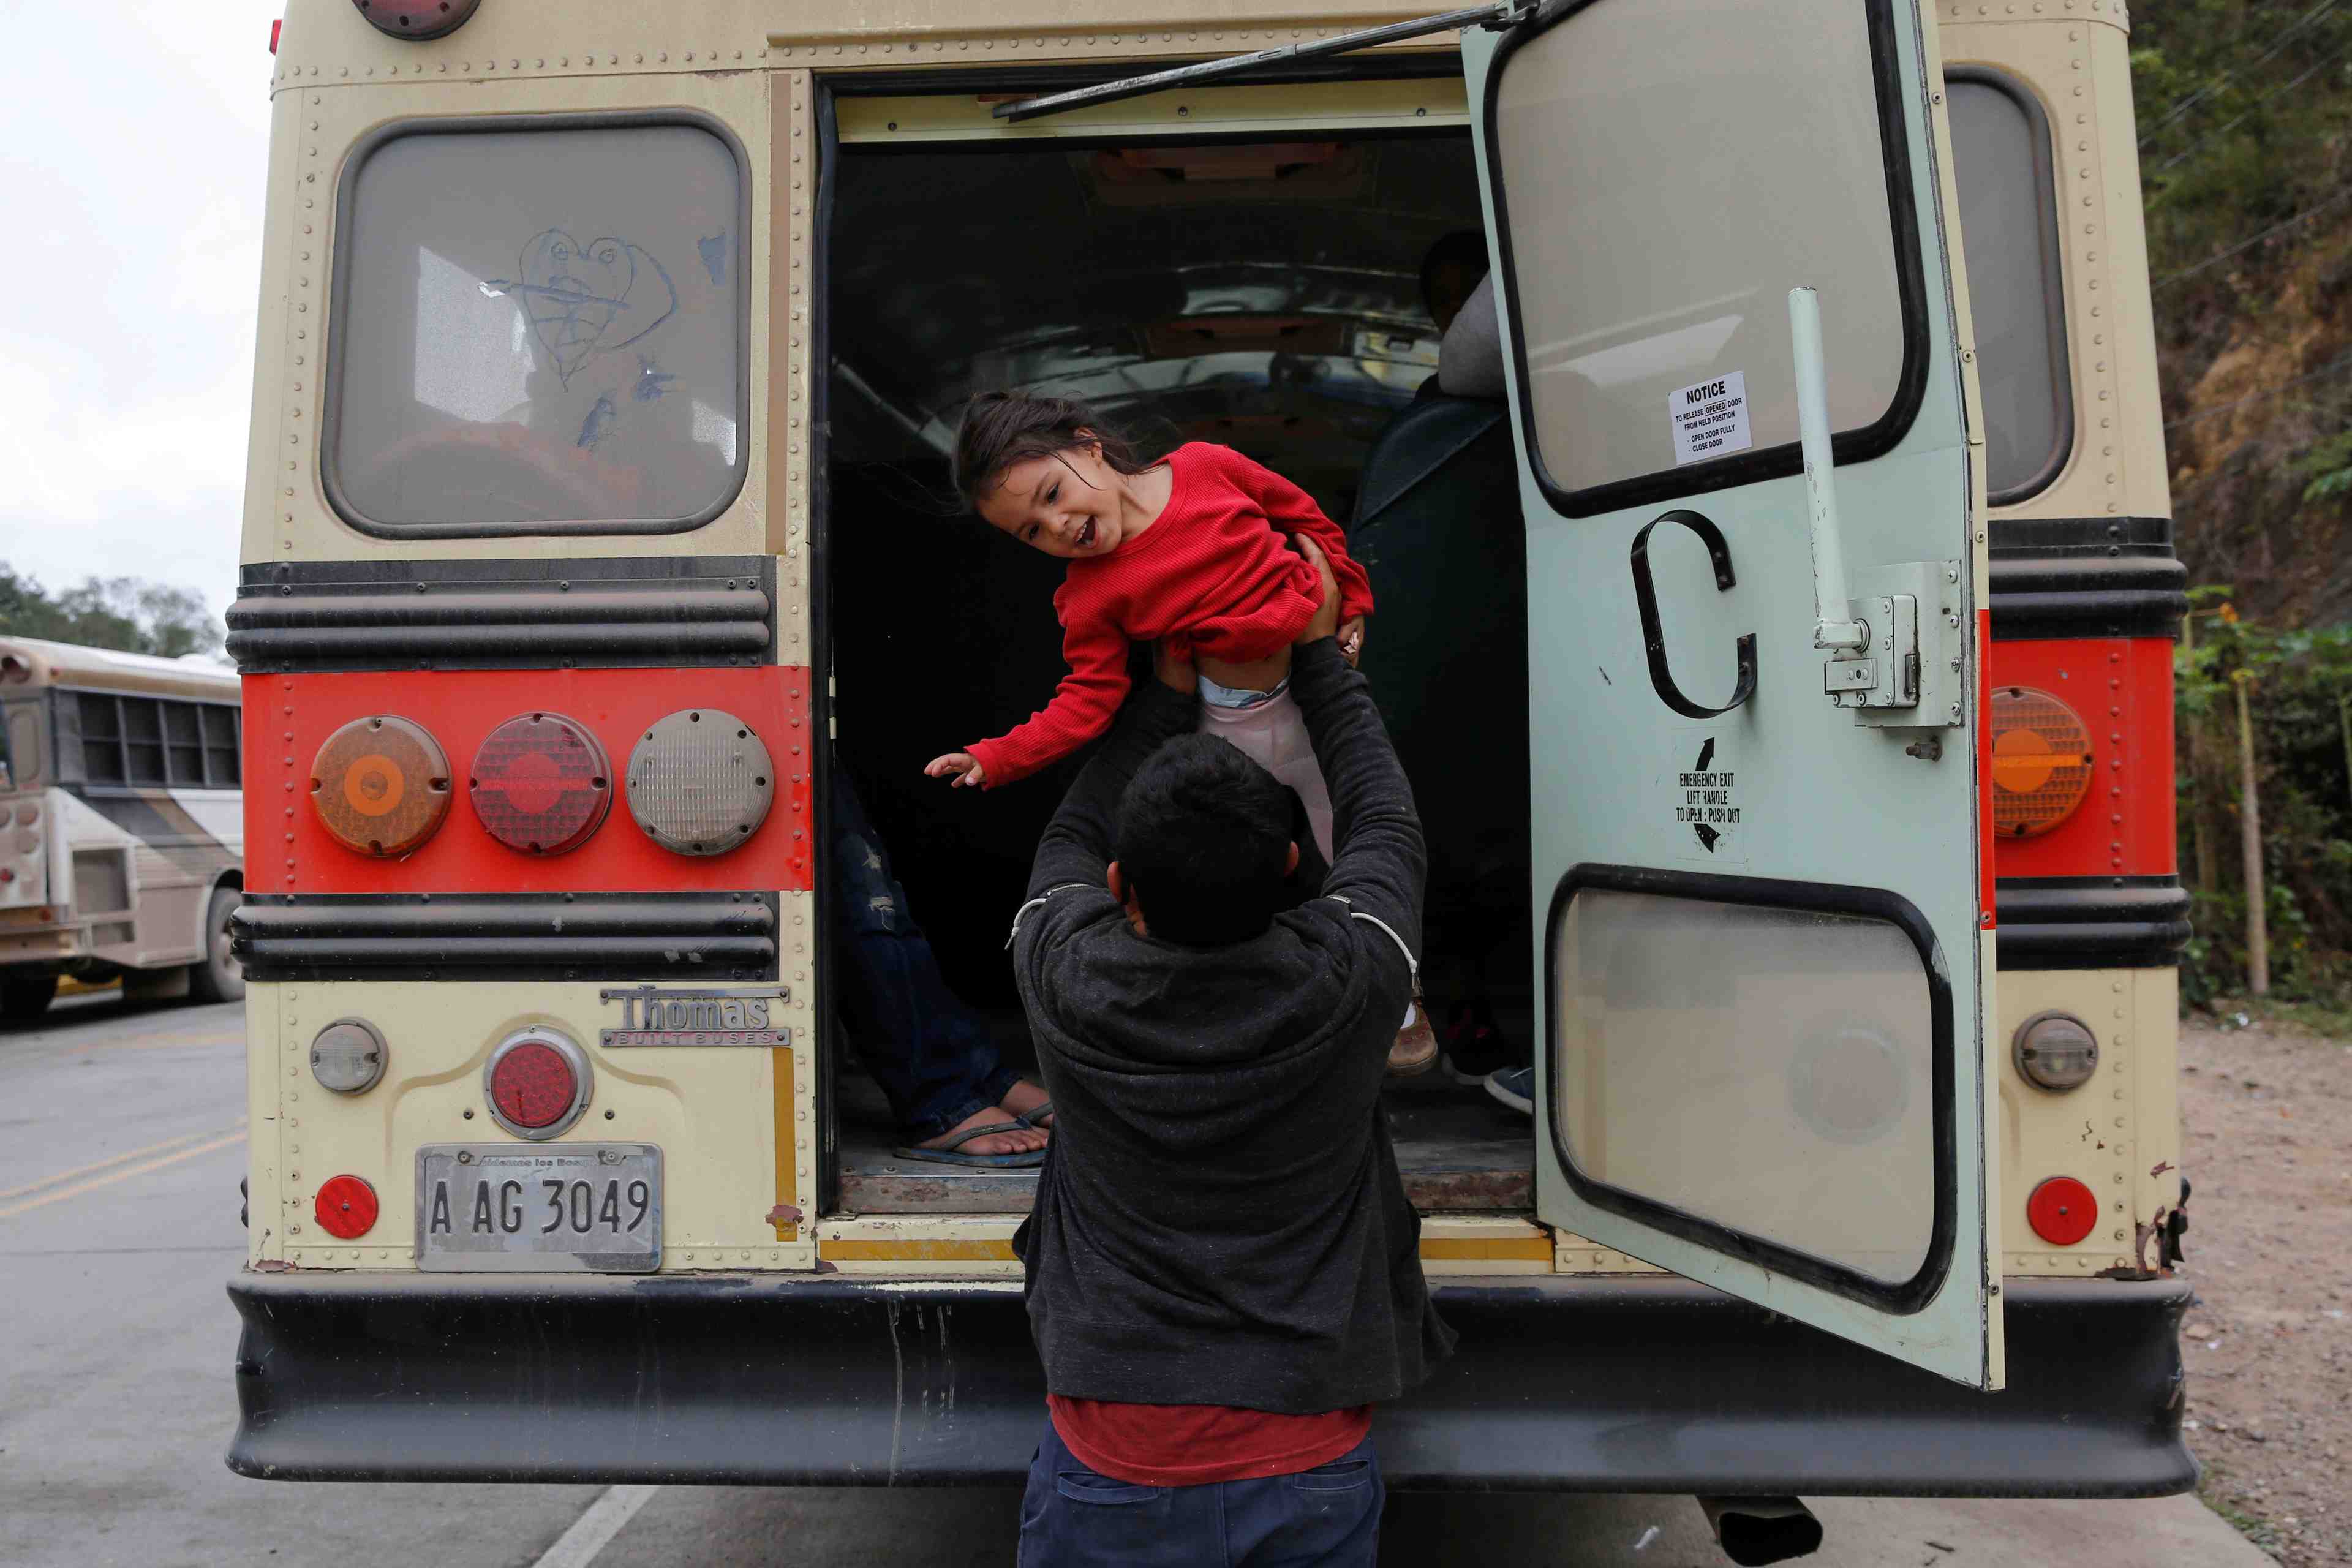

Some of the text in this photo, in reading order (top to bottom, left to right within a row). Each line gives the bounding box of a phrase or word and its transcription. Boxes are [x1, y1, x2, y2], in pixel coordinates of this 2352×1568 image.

[1686, 380, 1725, 404] NOTICE
[1683, 409, 1703, 421] RELEASE
[1705, 402, 1725, 414] OPENED
[1727, 397, 1742, 407] DOOR
[1684, 410, 1735, 431] FROM HELD POSITION
[1691, 424, 1735, 442] OPEN DOOR FULLY
[1692, 438, 1723, 452] CLOSE DOOR
[1679, 772, 1734, 787] EMERGENCY EXIT
[1687, 790, 1700, 804] LIFT
[1676, 807, 1740, 823] TO OPEN PUSH OUT
[600, 984, 771, 1030] Thomas
[618, 1033, 772, 1044] BUILT BUSES
[431, 1179, 649, 1234] A AG 3049
